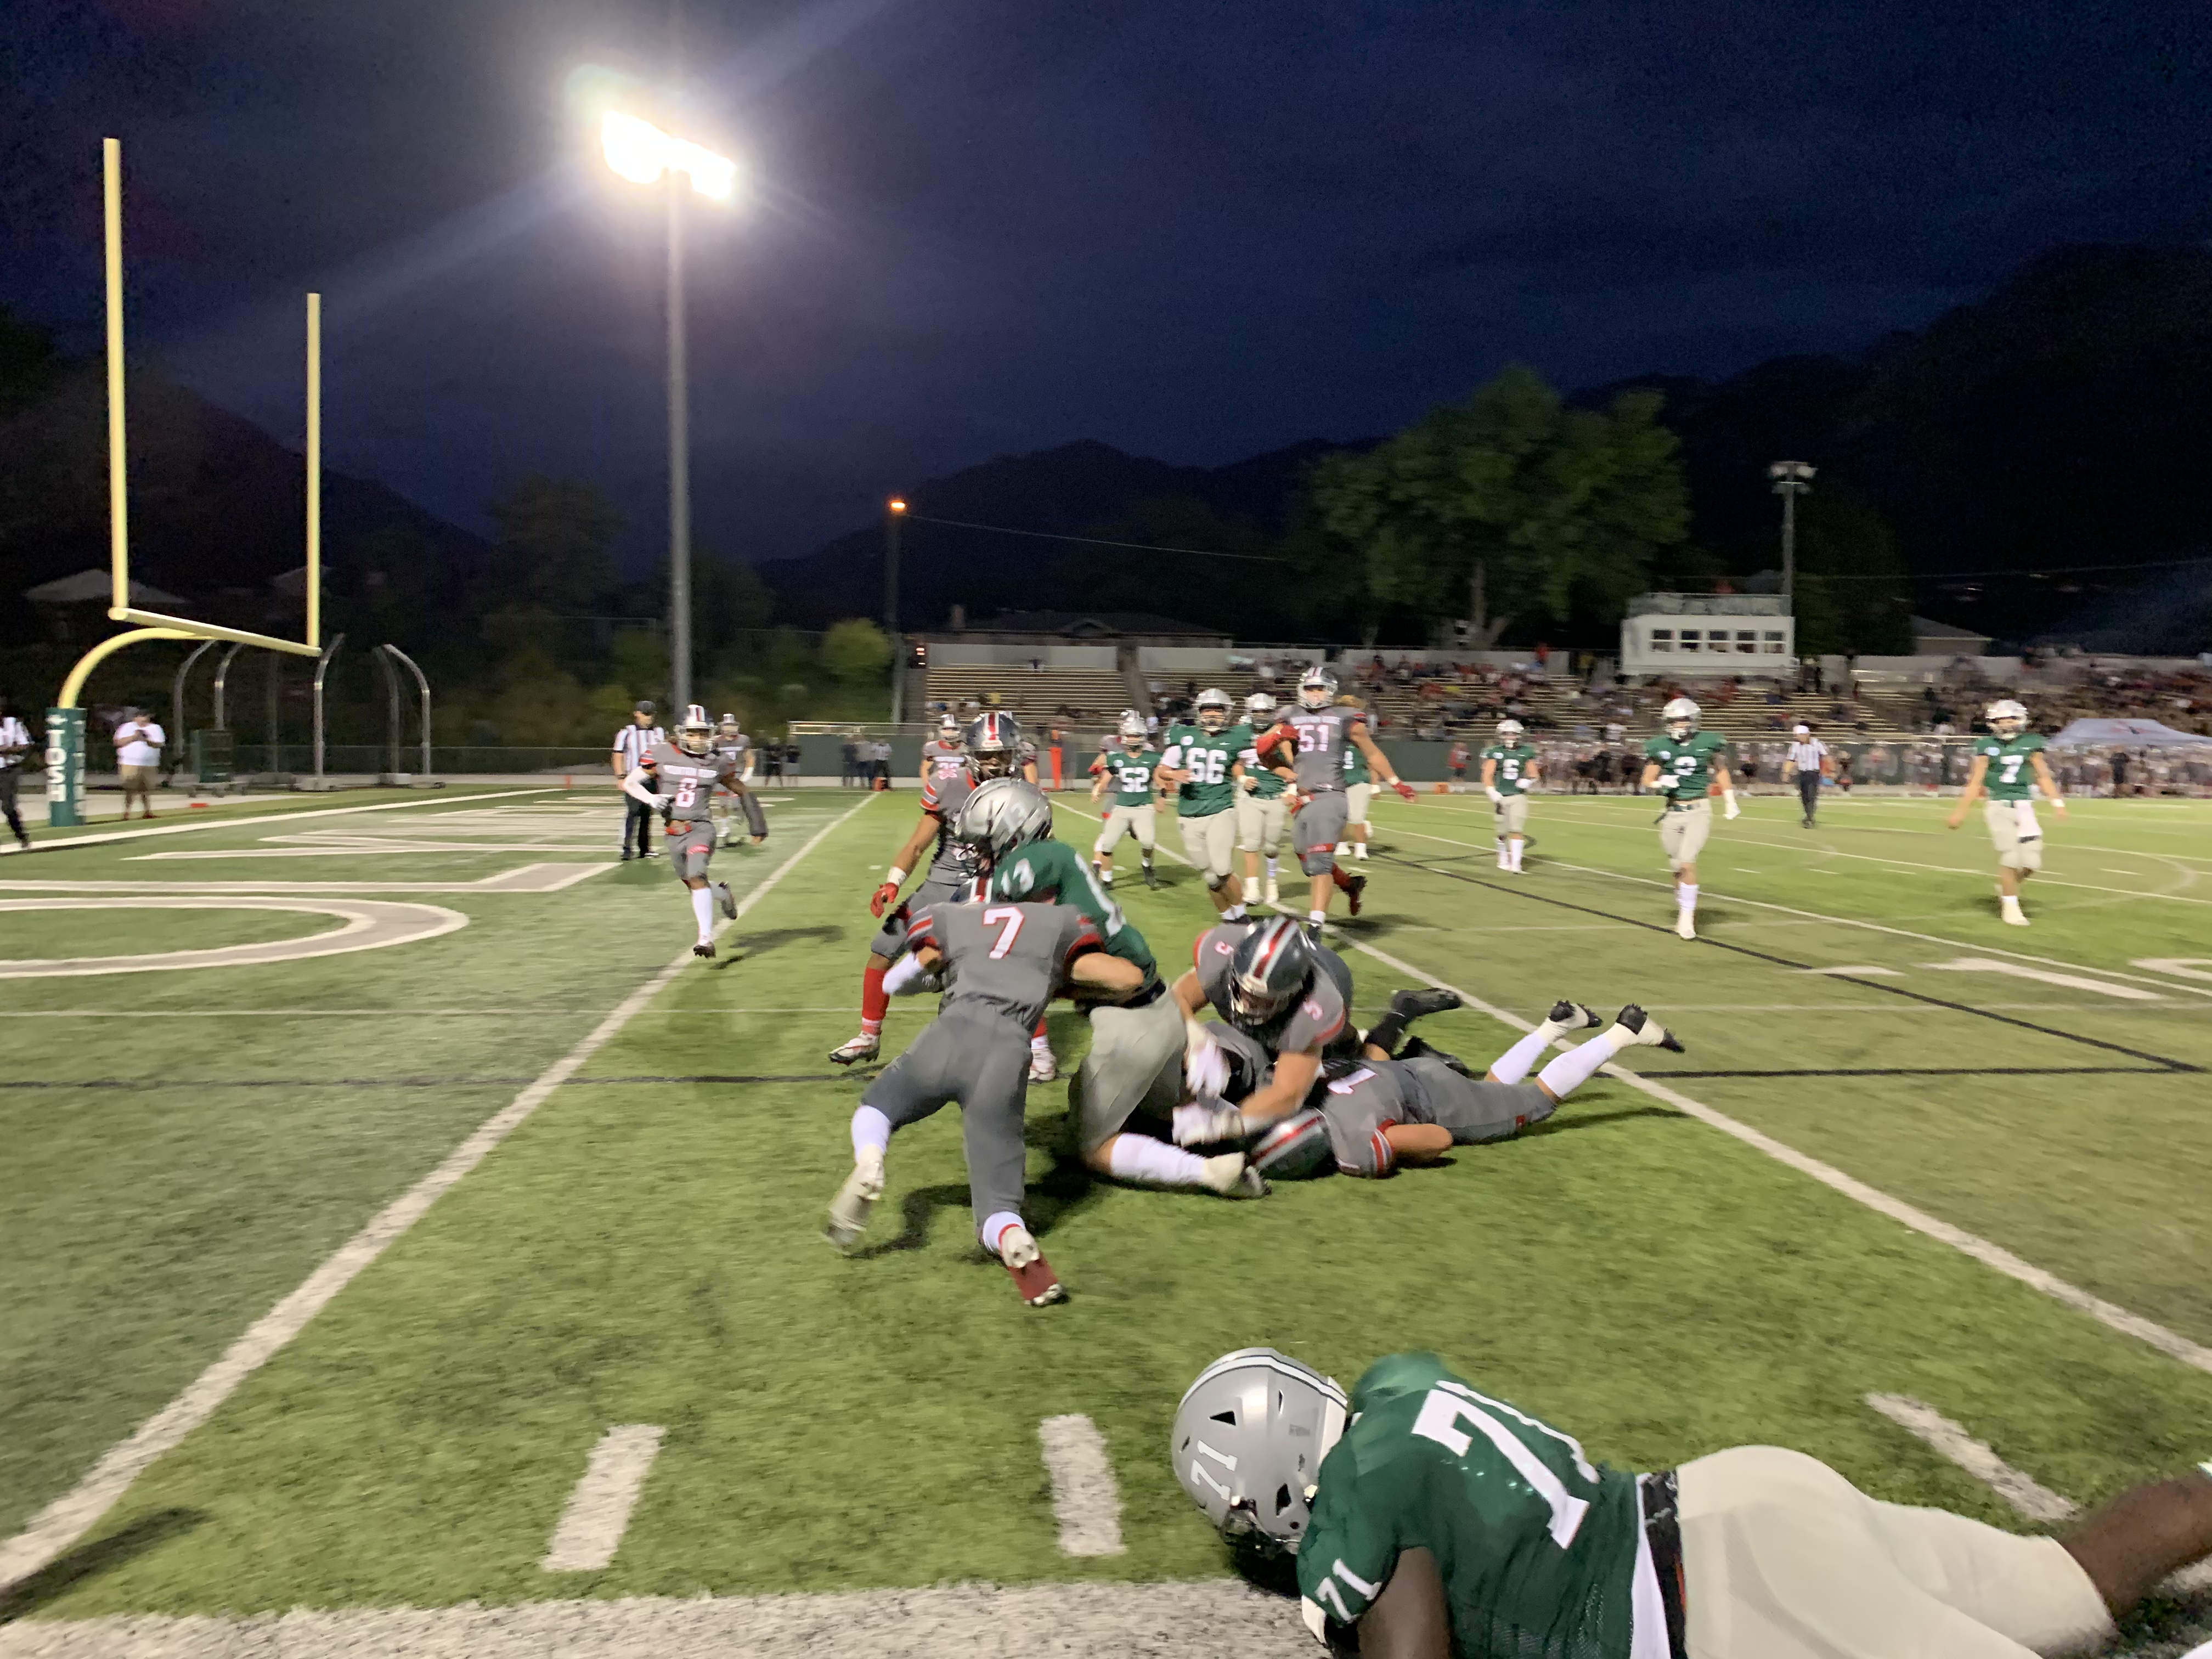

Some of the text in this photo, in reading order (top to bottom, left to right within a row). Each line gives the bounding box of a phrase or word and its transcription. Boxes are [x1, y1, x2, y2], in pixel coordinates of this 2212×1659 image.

[1296, 724, 1329, 752] 51
[1118, 766, 1150, 792] 52
[1186, 747, 1228, 784] 66
[1998, 755, 2024, 783] 7
[982, 906, 1025, 960] 7
[1190, 1439, 1238, 1501] 71
[1411, 1380, 1600, 1550] 71
[1315, 1558, 1383, 1623] 71
